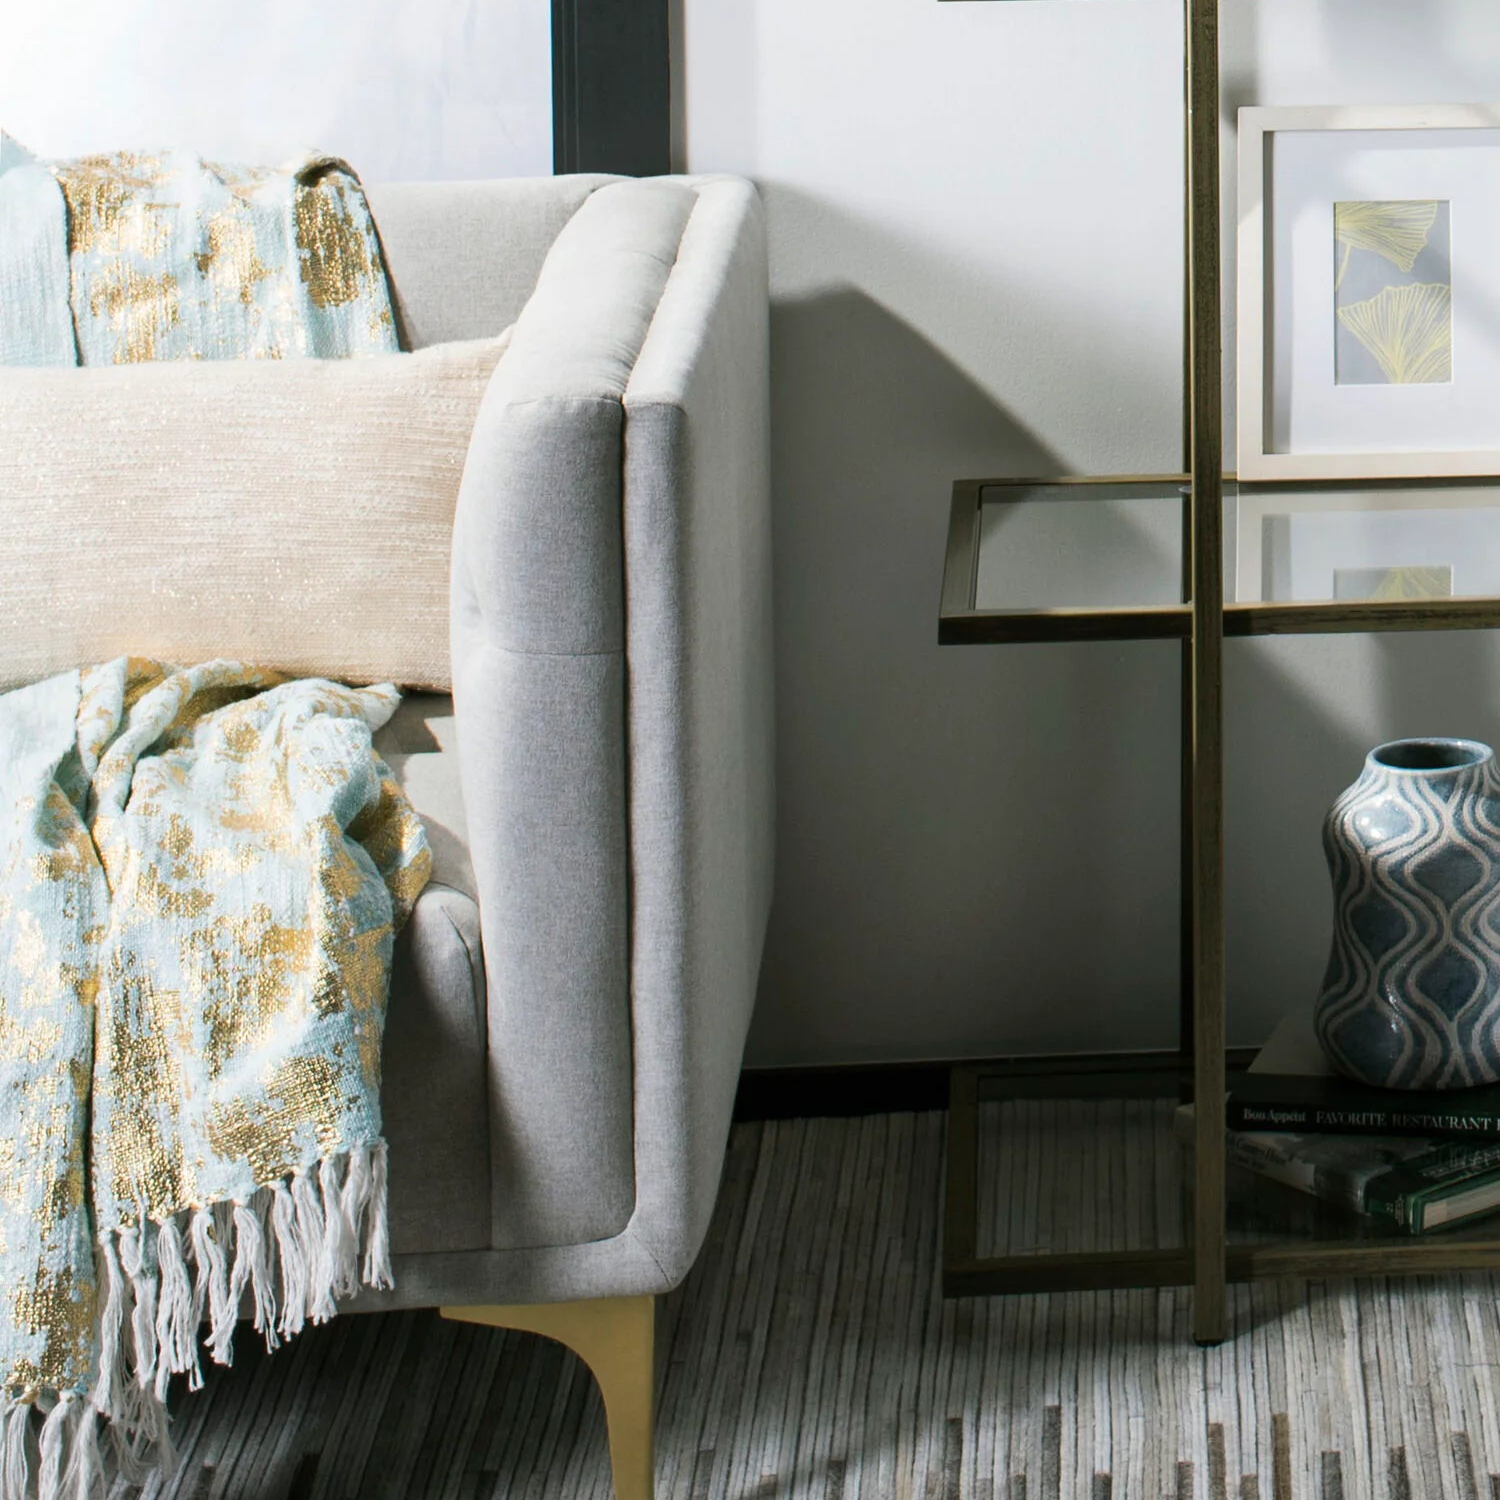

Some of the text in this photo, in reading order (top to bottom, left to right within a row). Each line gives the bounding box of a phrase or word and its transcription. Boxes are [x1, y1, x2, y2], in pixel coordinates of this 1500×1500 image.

[1243, 1107, 1266, 1121] Bon
[1315, 1110, 1388, 1127] FAVORITE
[1391, 1112, 1492, 1132] RESTAURANT
